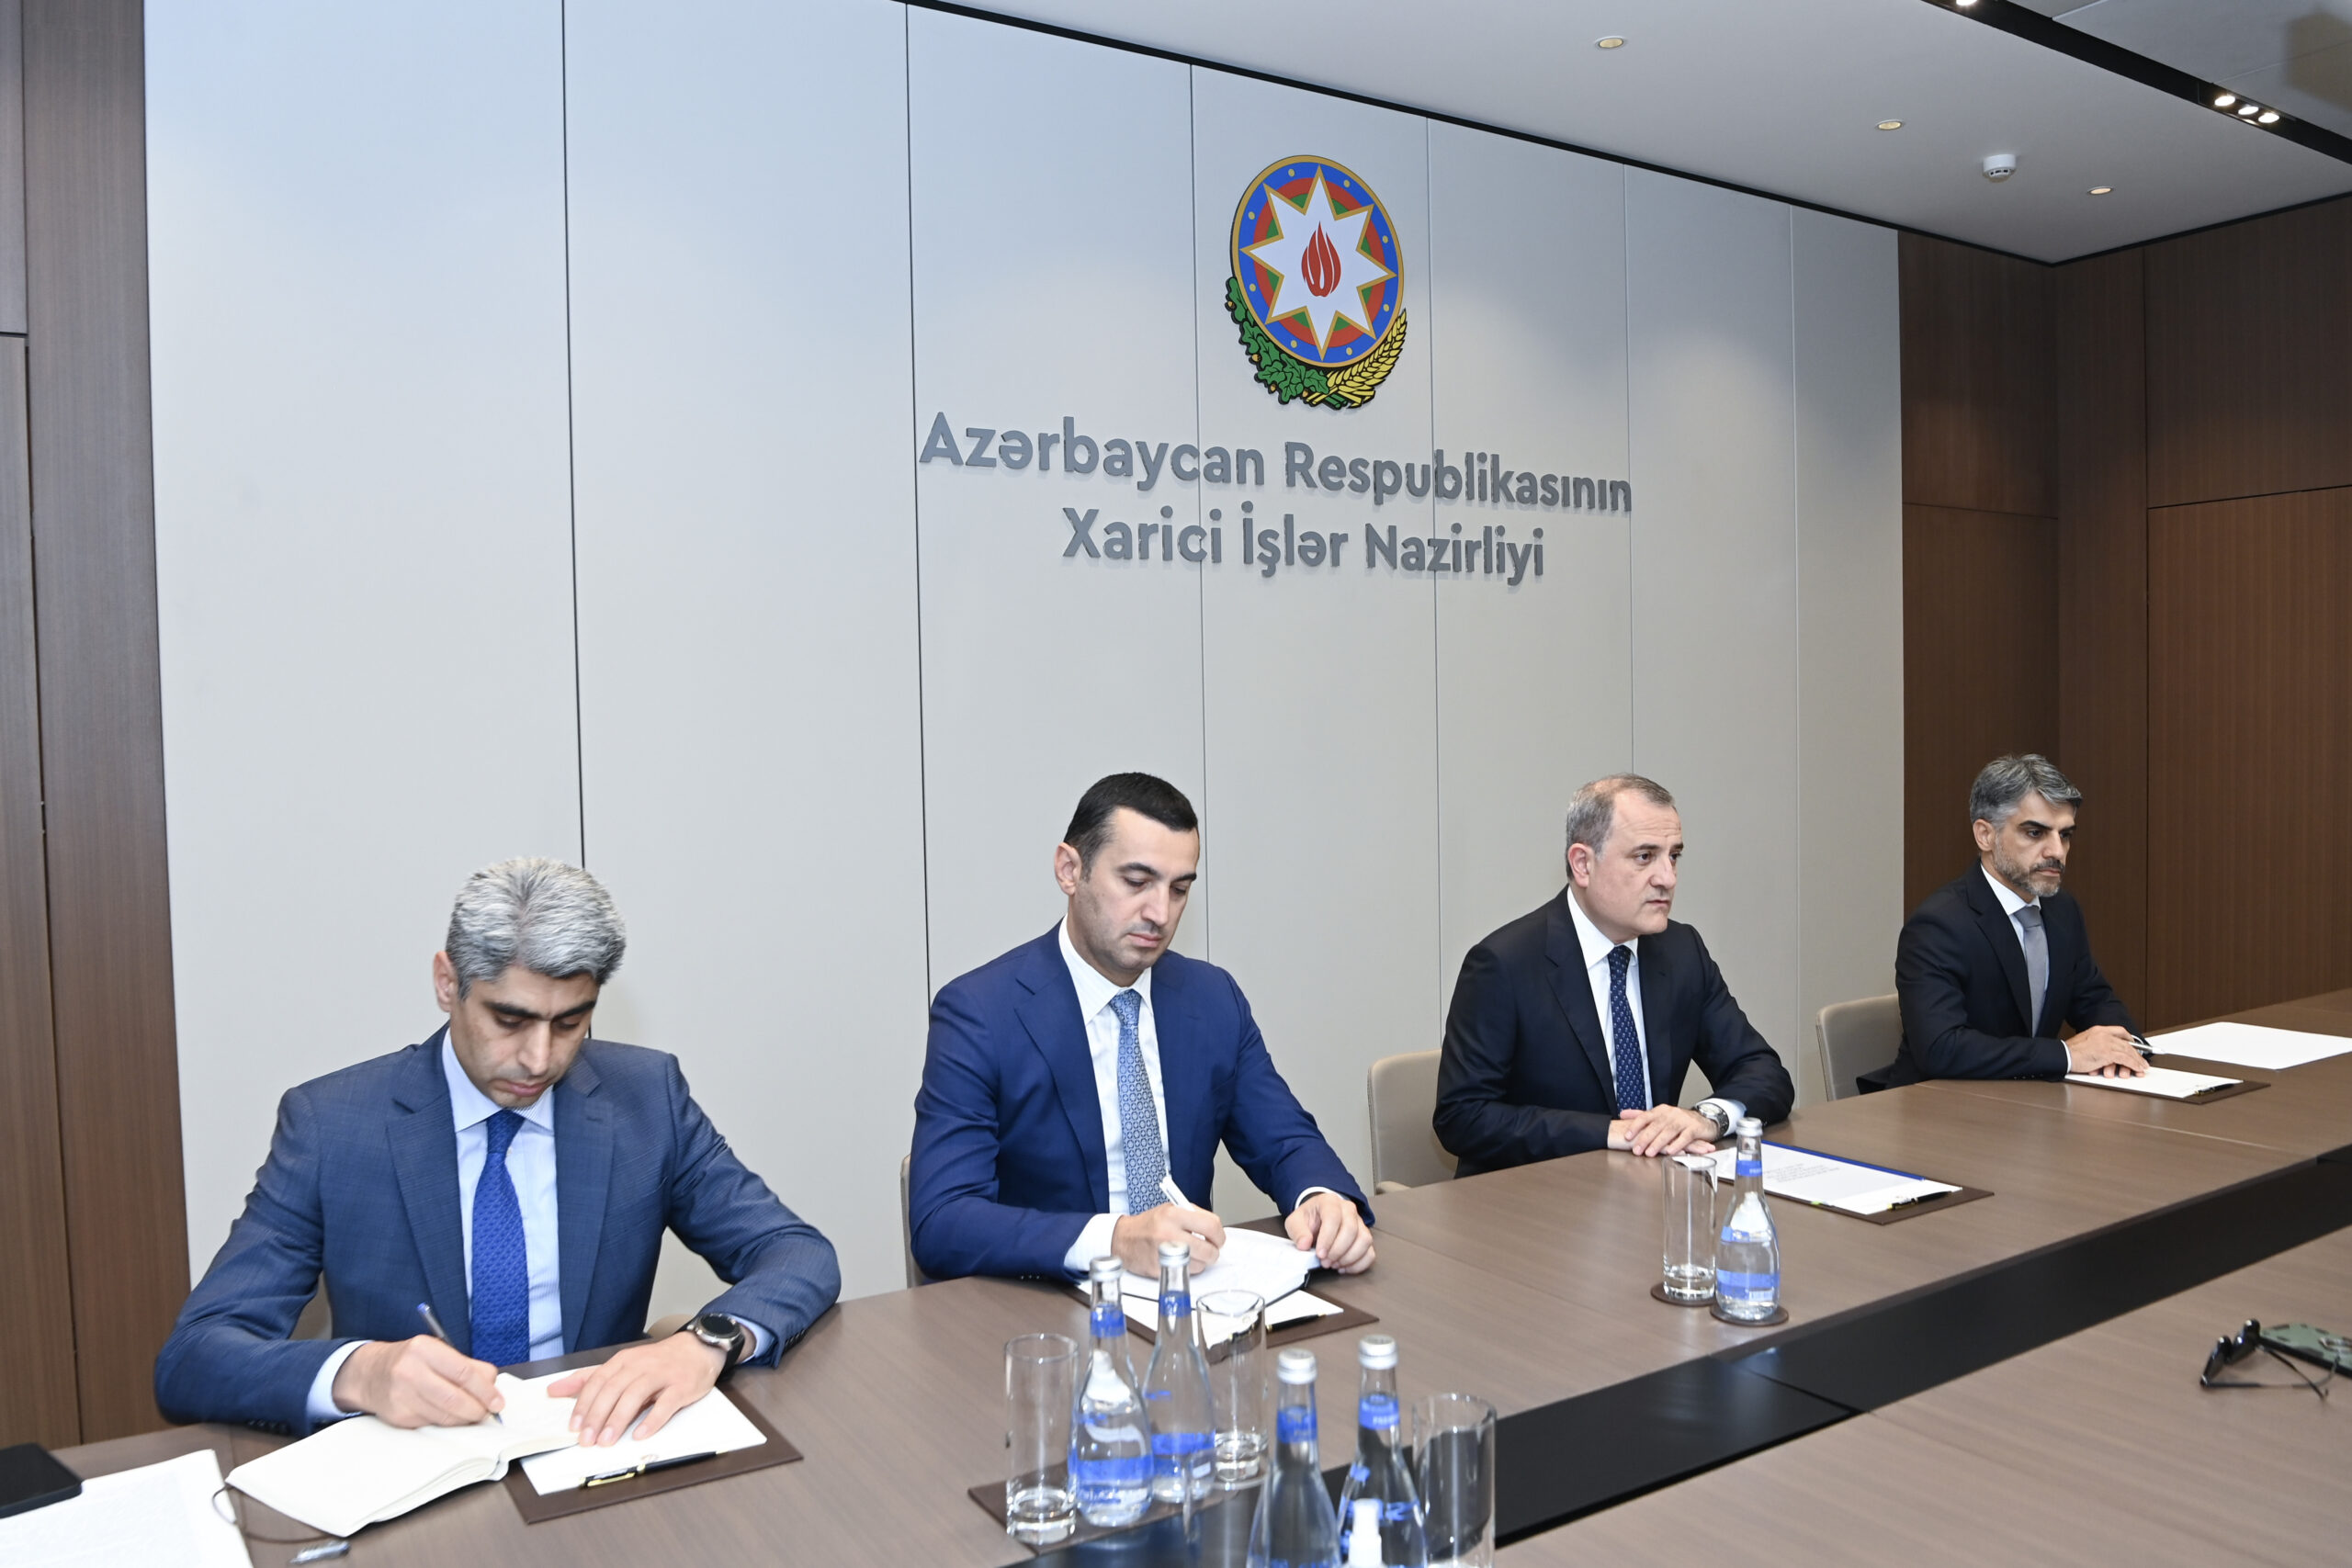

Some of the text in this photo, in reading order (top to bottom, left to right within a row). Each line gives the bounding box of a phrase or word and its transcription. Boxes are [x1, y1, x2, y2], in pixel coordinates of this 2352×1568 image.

[919, 412, 1633, 513] Azərbaycan Respublikasının
[1062, 501, 1544, 588] Xarici İşlər Nazirliyi
